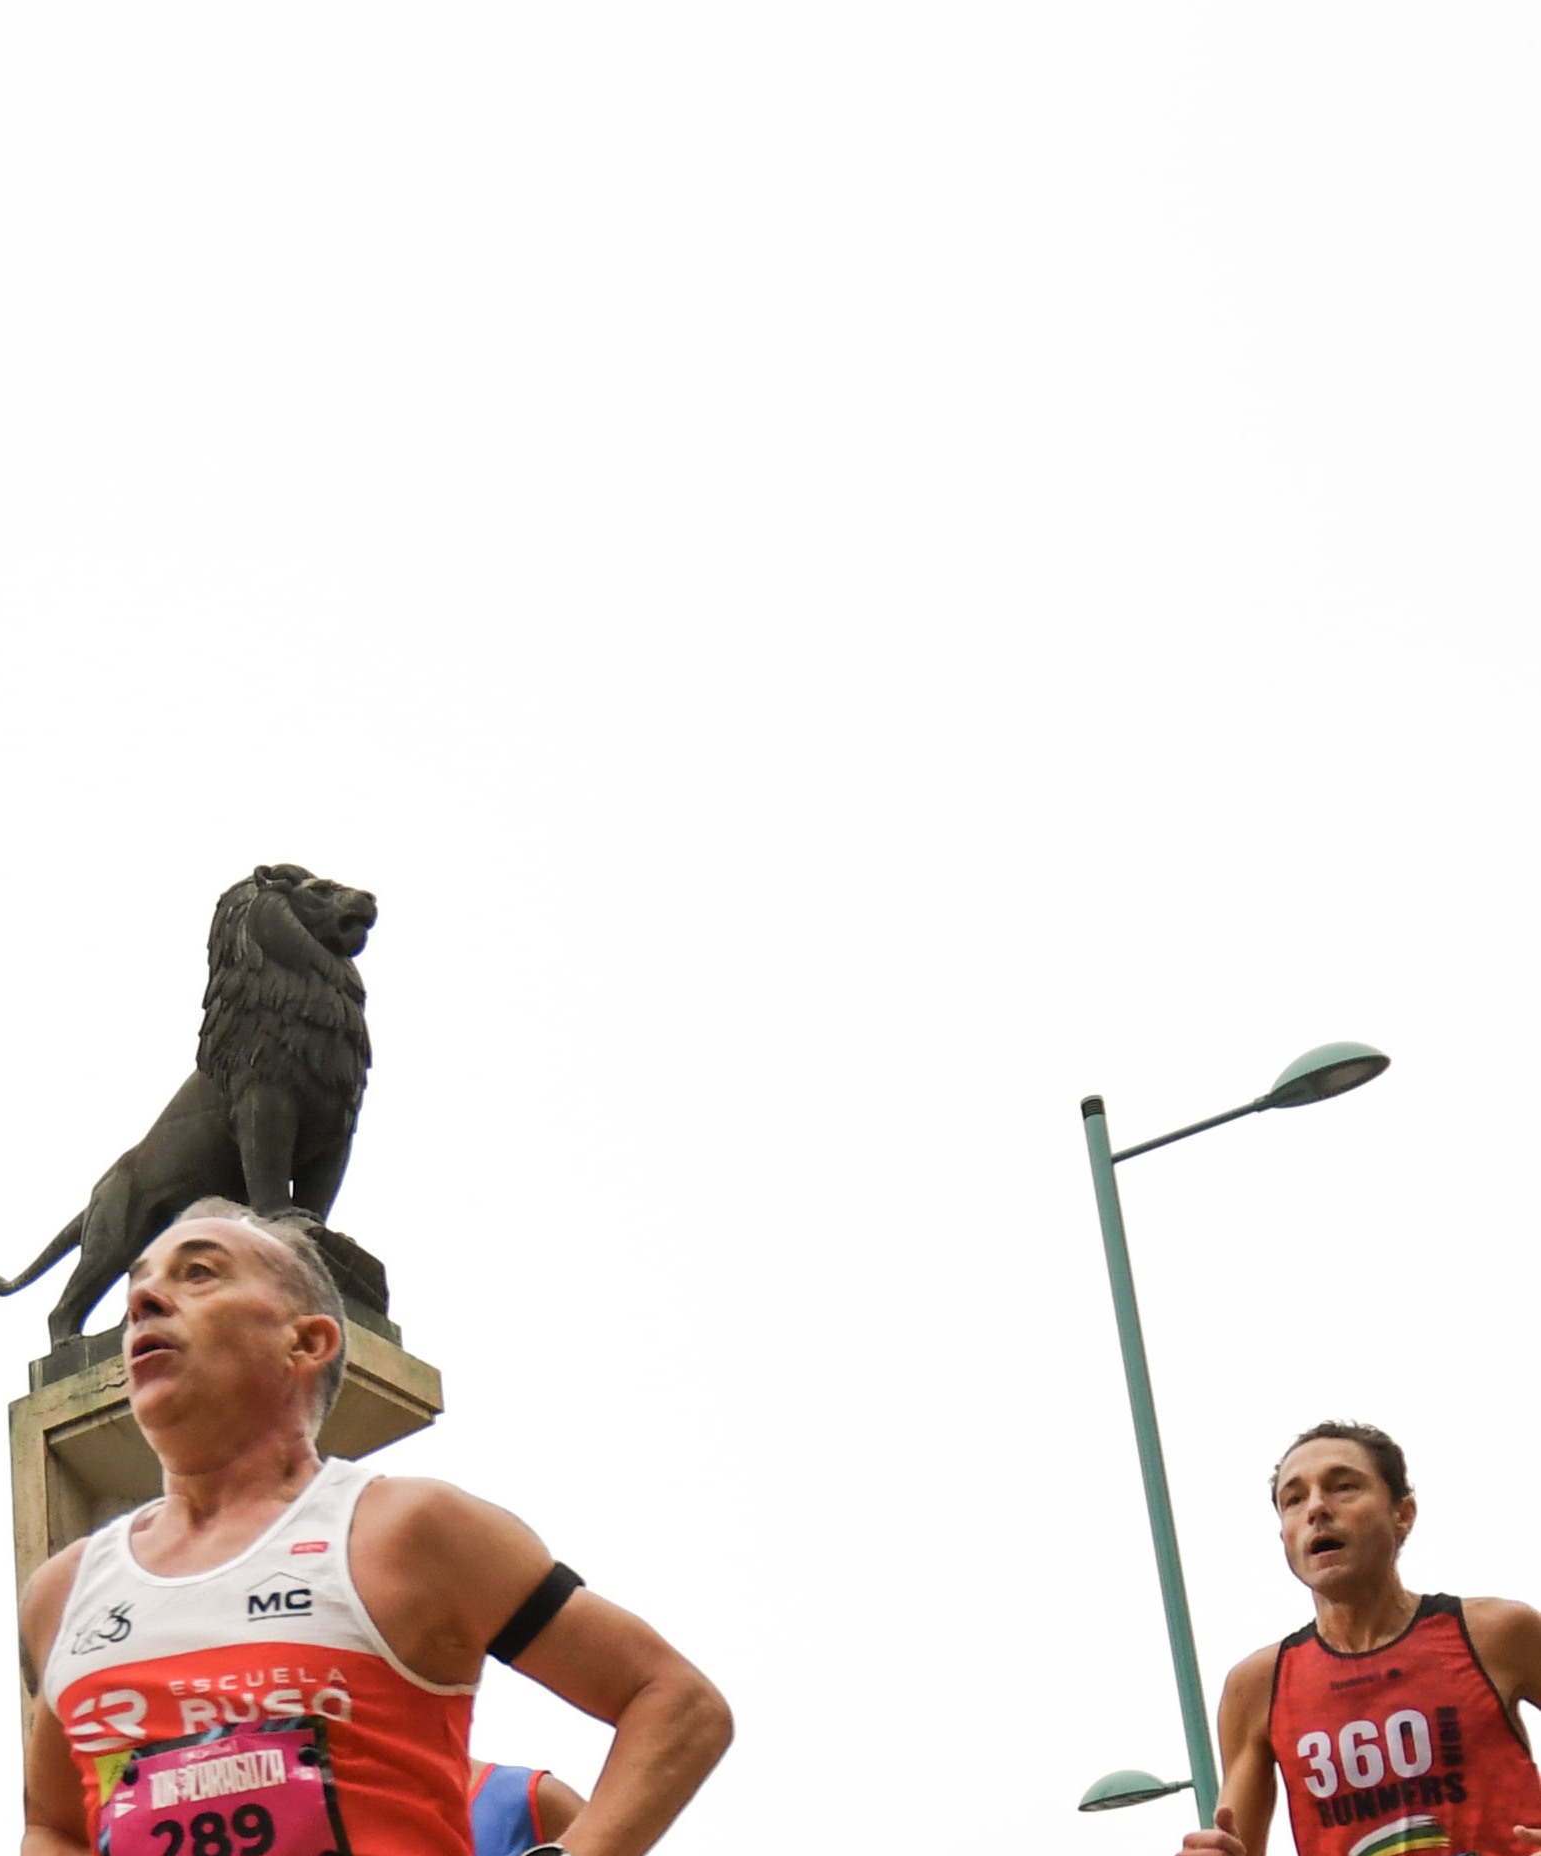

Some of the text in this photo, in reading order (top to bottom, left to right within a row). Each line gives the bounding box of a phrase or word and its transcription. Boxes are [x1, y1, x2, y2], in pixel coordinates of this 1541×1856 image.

[247, 1588, 312, 1613] MC
[168, 1667, 347, 1697] ESCUELA
[180, 1688, 352, 1735] RUSO
[1297, 1709, 1432, 1798] 360
